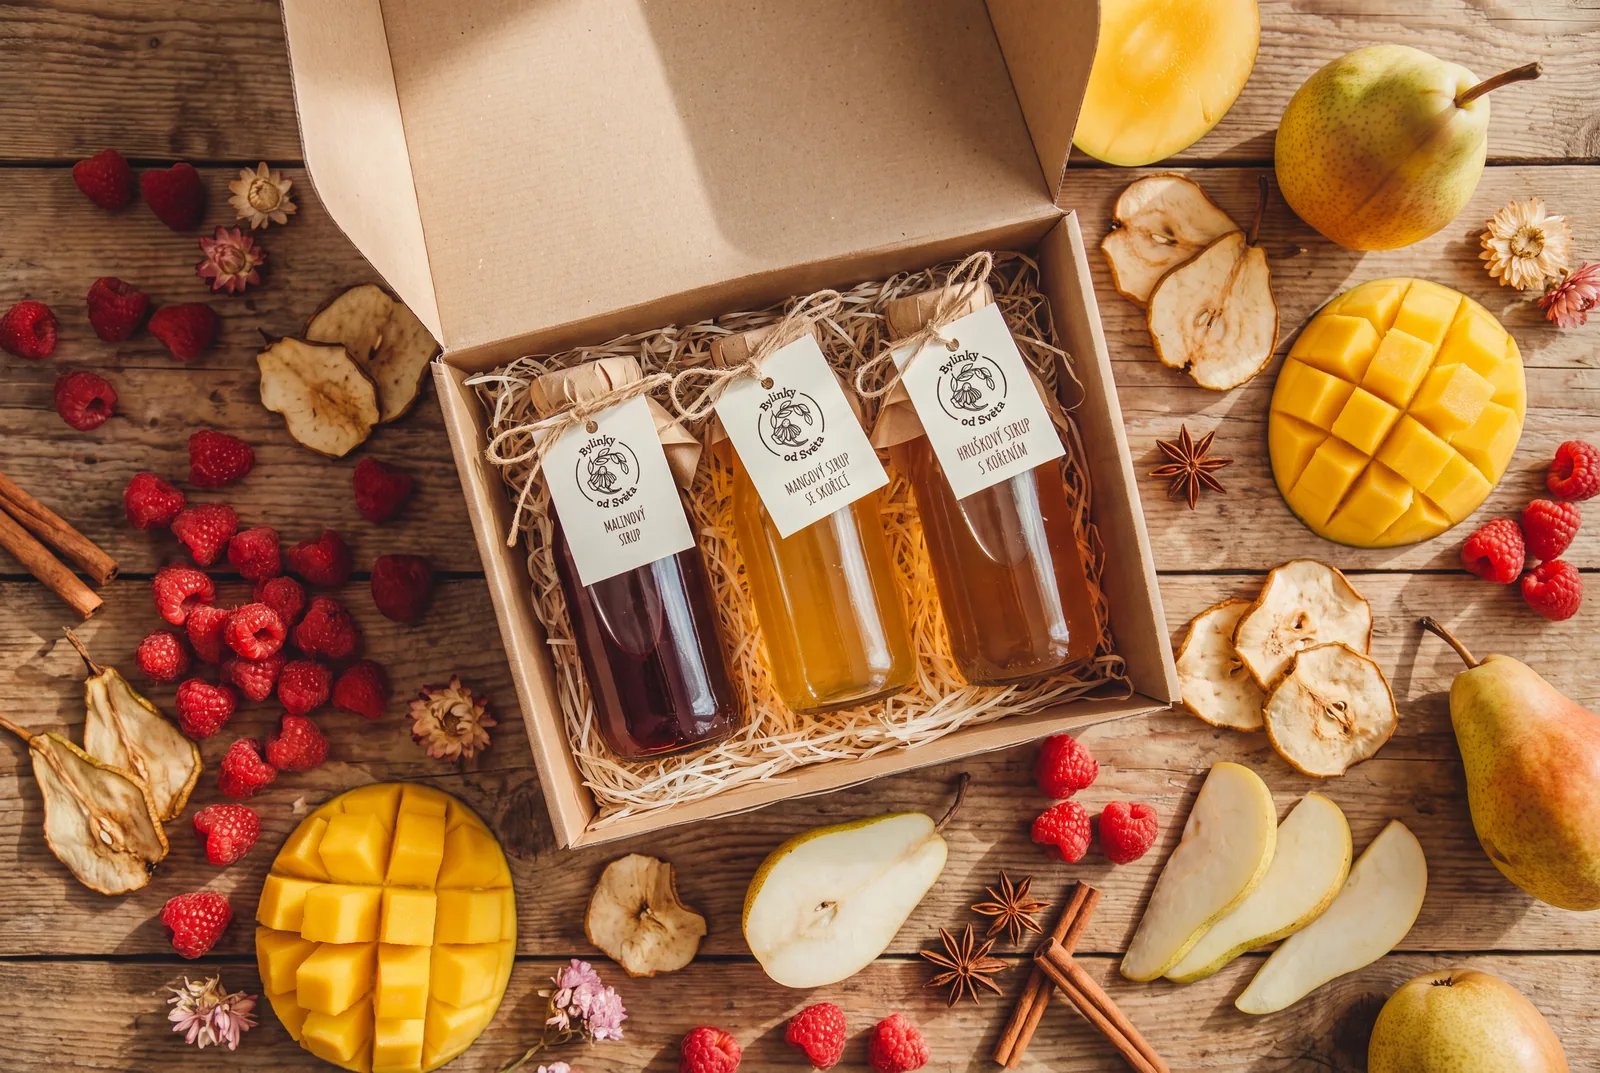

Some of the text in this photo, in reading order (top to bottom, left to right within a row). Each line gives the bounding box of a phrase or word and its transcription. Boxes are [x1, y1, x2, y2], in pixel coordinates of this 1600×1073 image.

[939, 350, 979, 375] Bylinky
[759, 387, 797, 412] Bylinky
[961, 401, 1006, 427] od Světa
[578, 434, 616, 457] Bylinky
[783, 436, 825, 462] od Světa
[956, 417, 1030, 461] HRUŠKOVÝ SIRUP
[977, 442, 1028, 475] S KOŘENÍM
[784, 452, 850, 496] MANGOVÝ SIRUP
[596, 486, 638, 508] od Světa
[804, 471, 851, 506] SE SKOŘICÍ
[603, 505, 646, 534] MALINOVÝ
[618, 528, 641, 546] SIRUP
